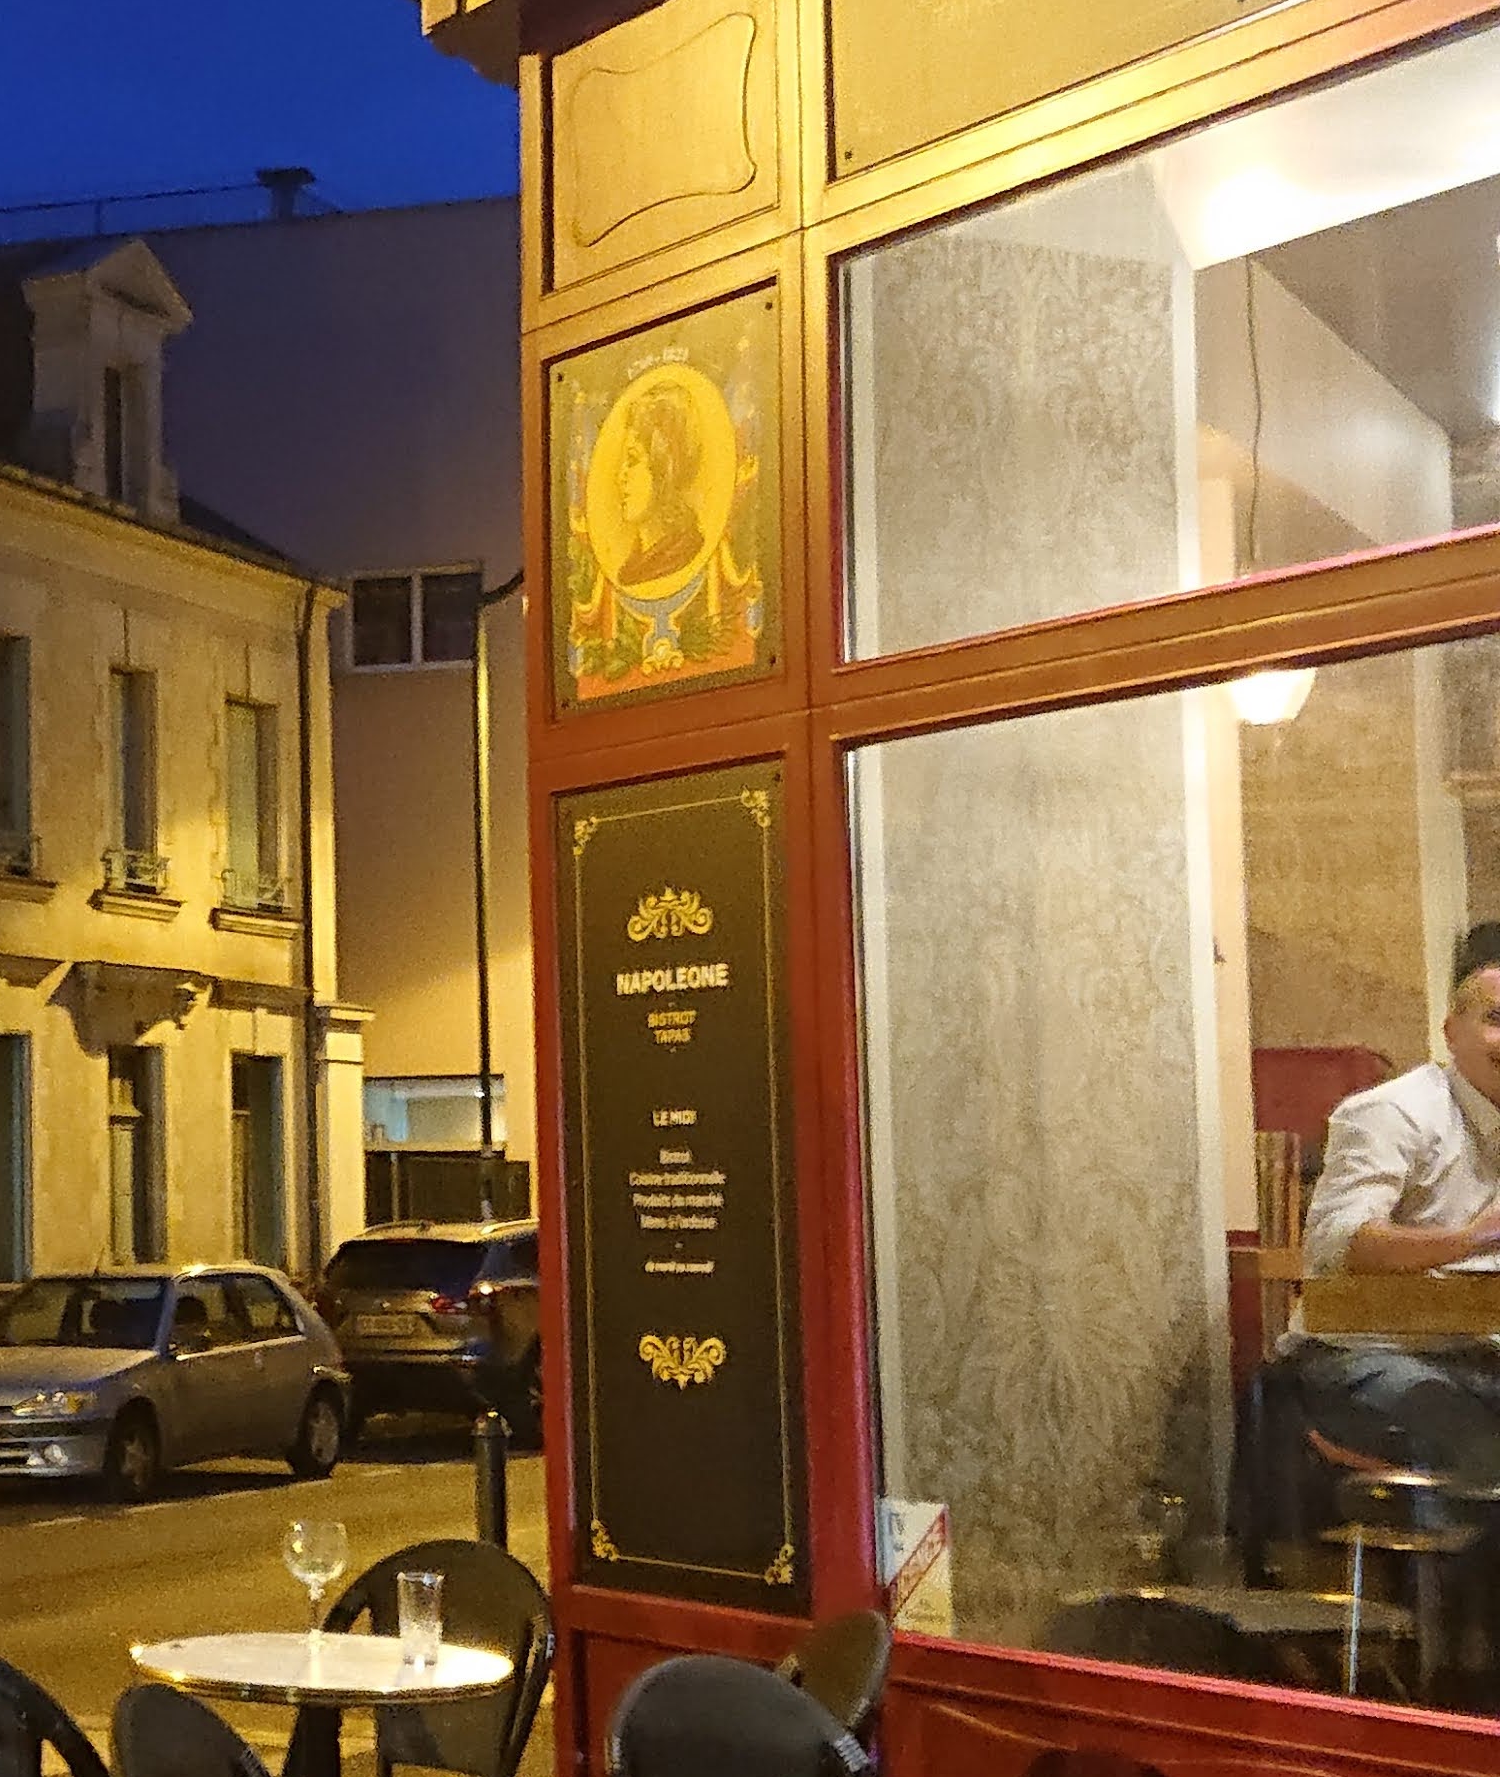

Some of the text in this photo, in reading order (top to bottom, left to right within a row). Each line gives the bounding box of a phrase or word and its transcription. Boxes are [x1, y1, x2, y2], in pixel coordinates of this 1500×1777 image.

[616, 962, 729, 995] NAPOLEONE
[647, 1009, 697, 1028] BISTROT
[653, 1027, 692, 1044] TAPAS
